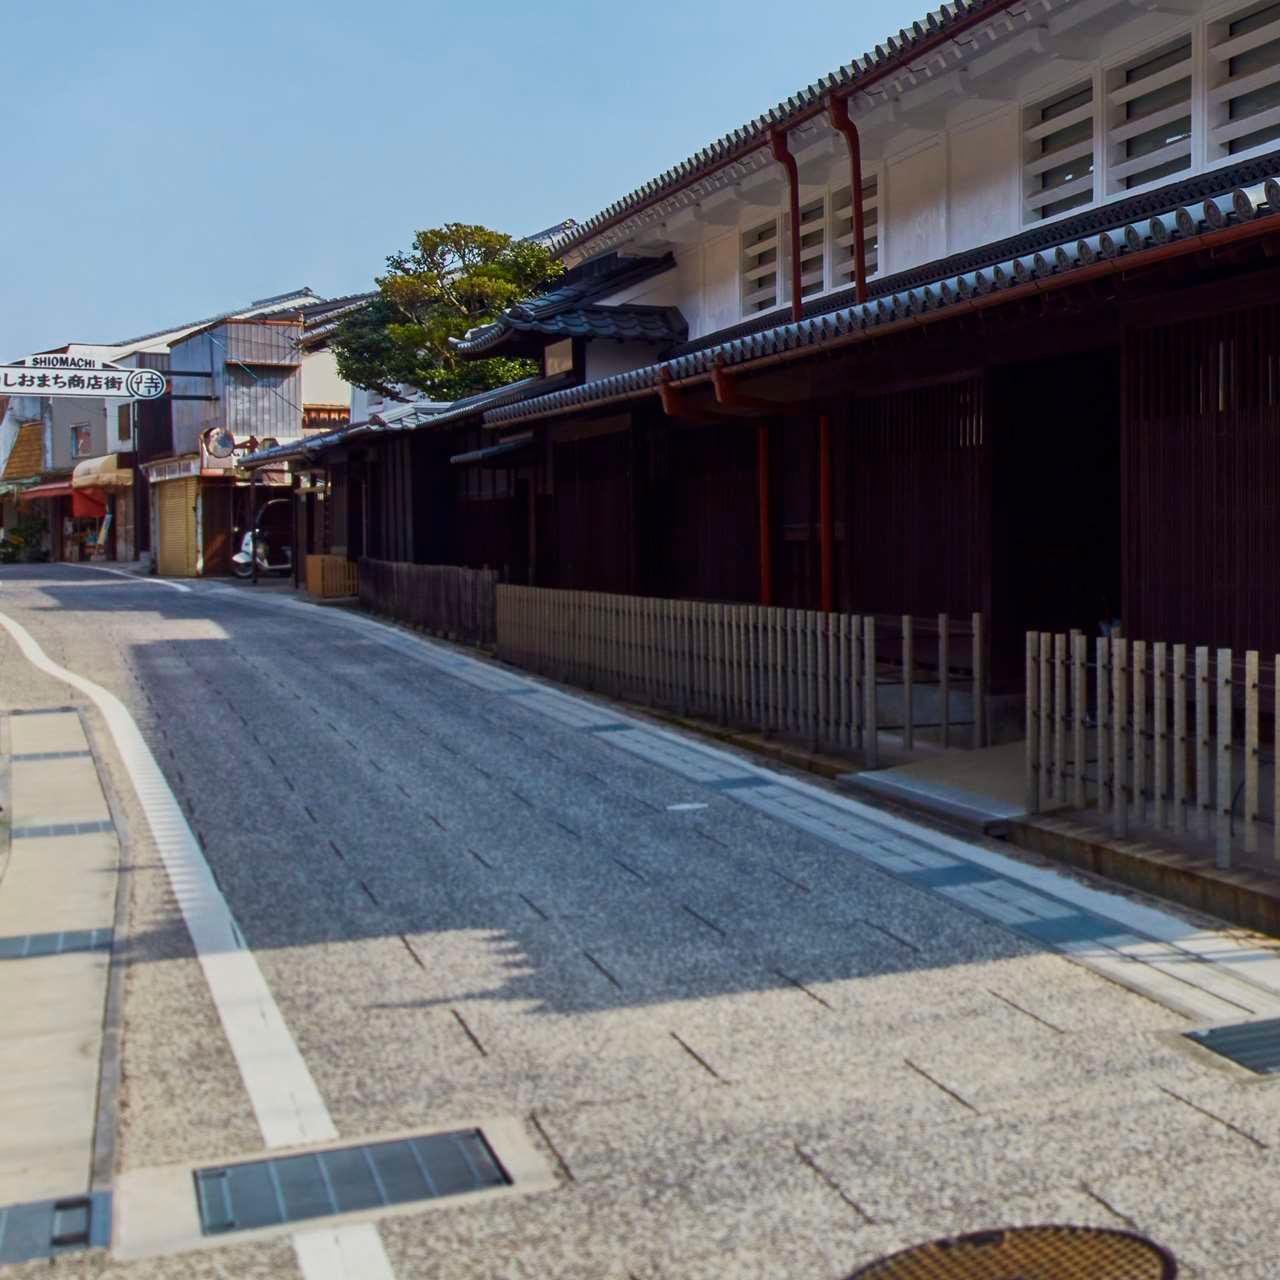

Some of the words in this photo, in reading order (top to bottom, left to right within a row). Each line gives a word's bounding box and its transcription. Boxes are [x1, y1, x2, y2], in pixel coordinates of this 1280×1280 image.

[32, 357, 95, 369] SHIOMACHI
[0, 373, 124, 391] しおまち商店街
